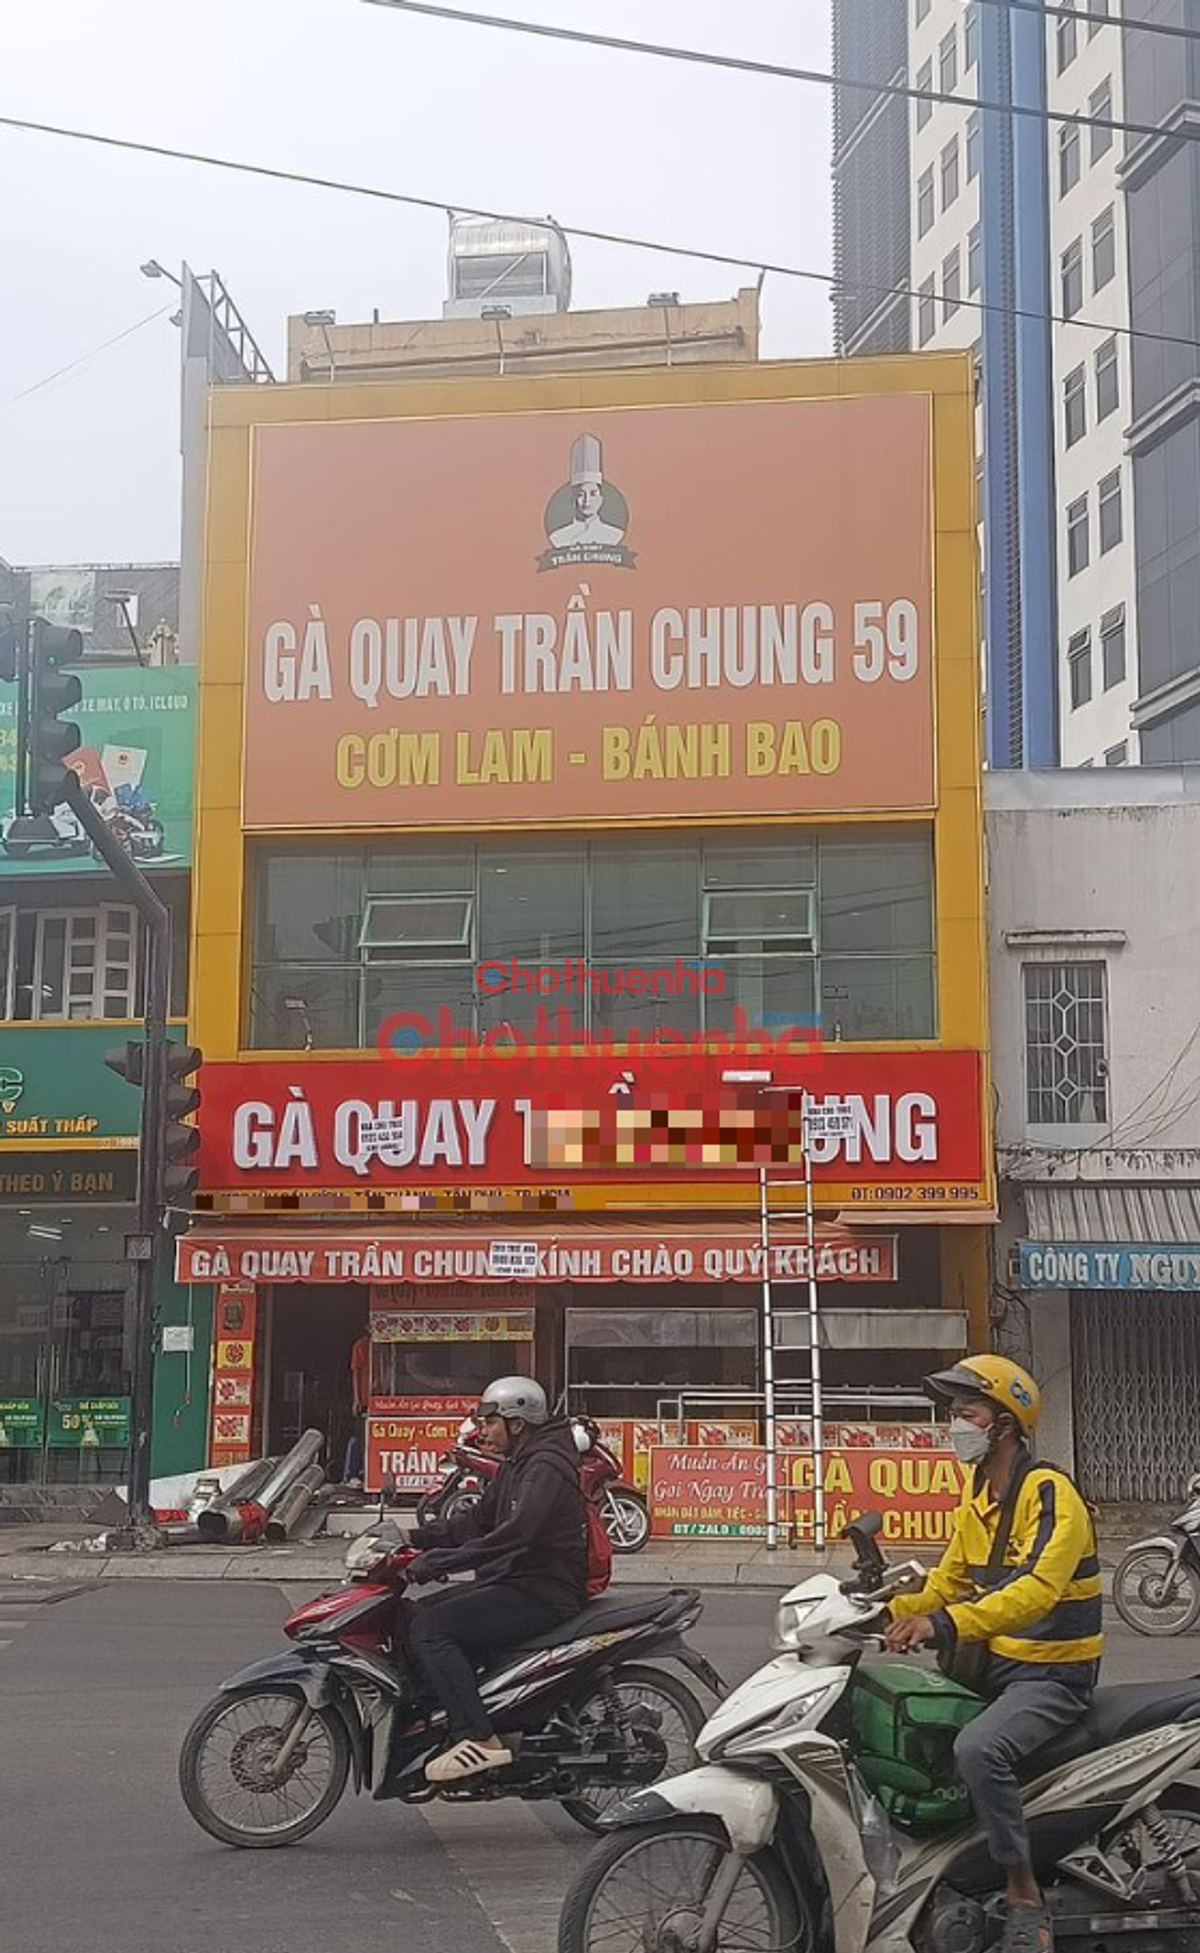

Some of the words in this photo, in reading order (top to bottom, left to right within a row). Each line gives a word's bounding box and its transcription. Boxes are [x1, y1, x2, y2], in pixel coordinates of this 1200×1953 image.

[263, 603, 333, 704] GÀ
[349, 616, 478, 708] QUAY
[494, 583, 633, 695] TRẦN
[651, 600, 835, 690] CHUNG
[852, 599, 918, 682] 59
[336, 728, 440, 789] CƠM
[456, 729, 553, 785] LAM
[602, 714, 730, 781] BÁNH
[746, 719, 841, 777] BAO
[55, 1114, 98, 1132] THẤP
[234, 1086, 317, 1168] GÀ
[334, 1099, 496, 1175] QUAY
[191, 1246, 231, 1276] GÀ
[241, 1250, 314, 1279] QUAY
[325, 1241, 403, 1276] TRẦN
[537, 1246, 600, 1276] KÍNH
[612, 1243, 693, 1275] CHÀO
[704, 1243, 763, 1278] QUÝ
[775, 1243, 879, 1275] KHÁCH
[1029, 1247, 1088, 1281] CÔNG
[1095, 1254, 1119, 1281] TY
[379, 1443, 437, 1474] TRẦN
